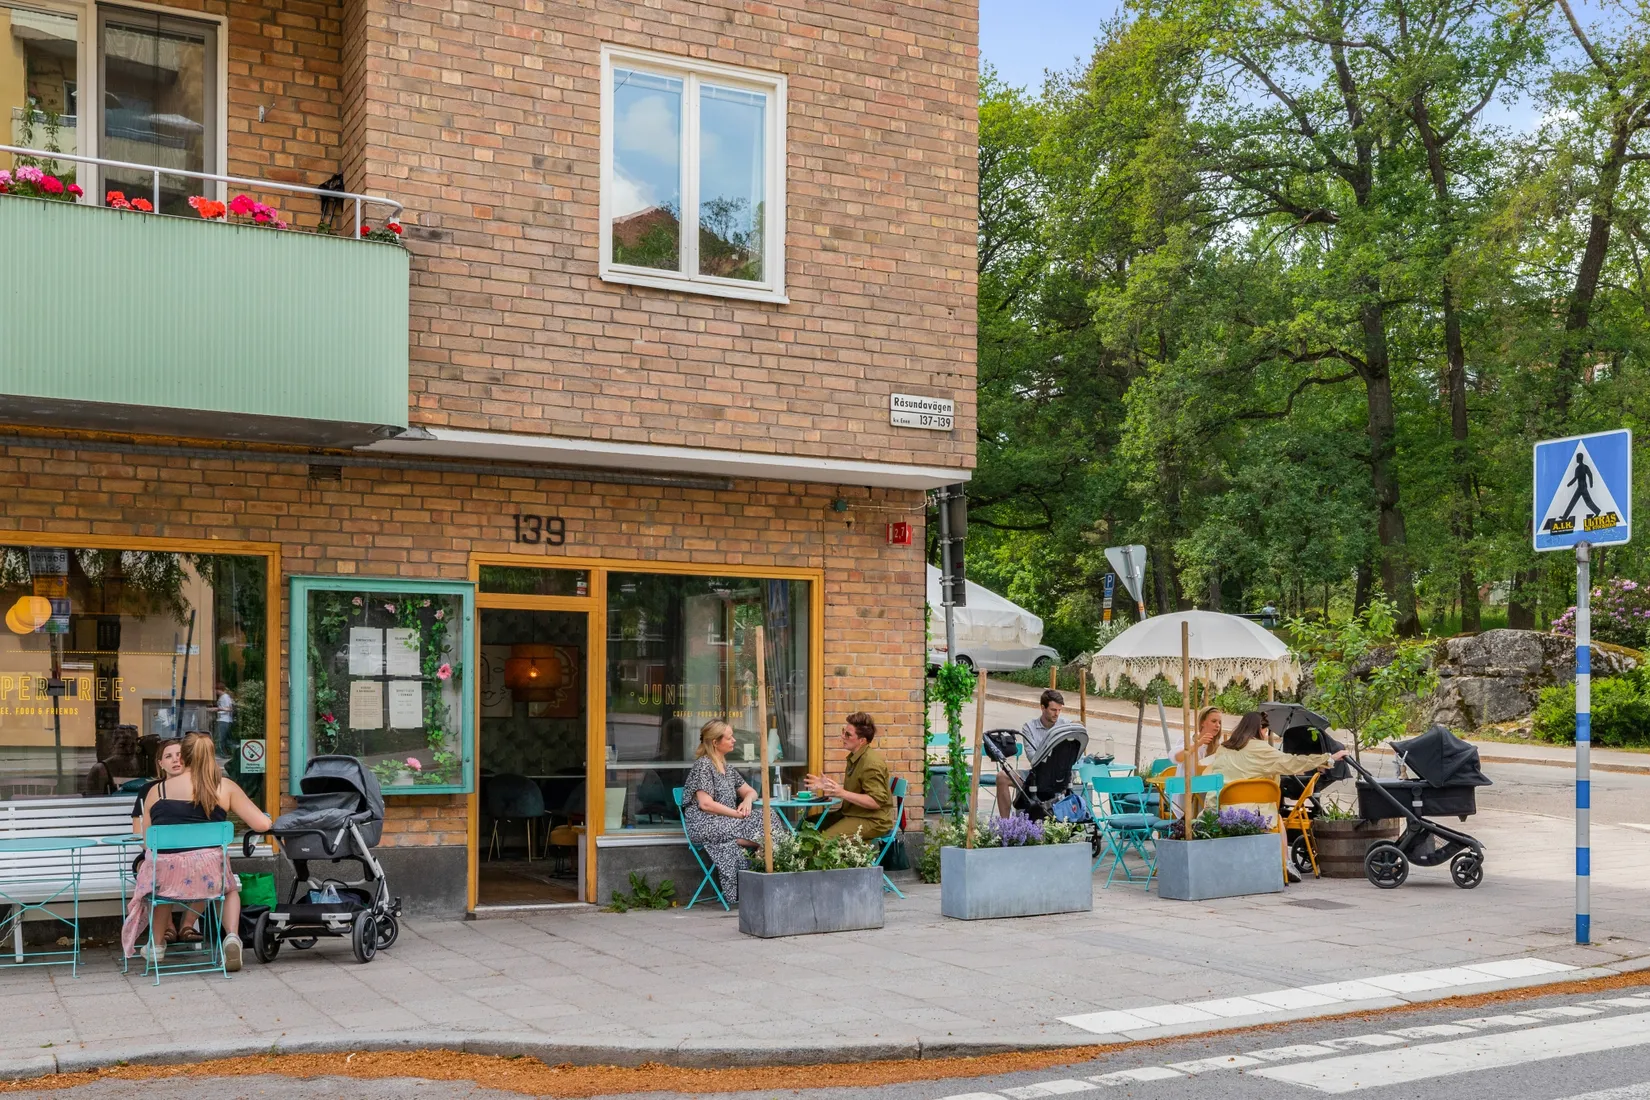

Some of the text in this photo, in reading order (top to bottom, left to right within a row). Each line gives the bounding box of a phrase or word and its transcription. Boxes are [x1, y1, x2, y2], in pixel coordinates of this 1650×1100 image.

[894, 397, 952, 413] Råsundavägen
[920, 414, 951, 428] 137-139
[1584, 513, 1617, 527] ULTRAS
[513, 513, 566, 546] 139
[1107, 575, 1112, 588] P
[61, 676, 124, 701] TREE
[639, 683, 776, 706] JUNIPER TRE
[15, 707, 35, 715] FOOD
[719, 710, 743, 718] FRENDS
